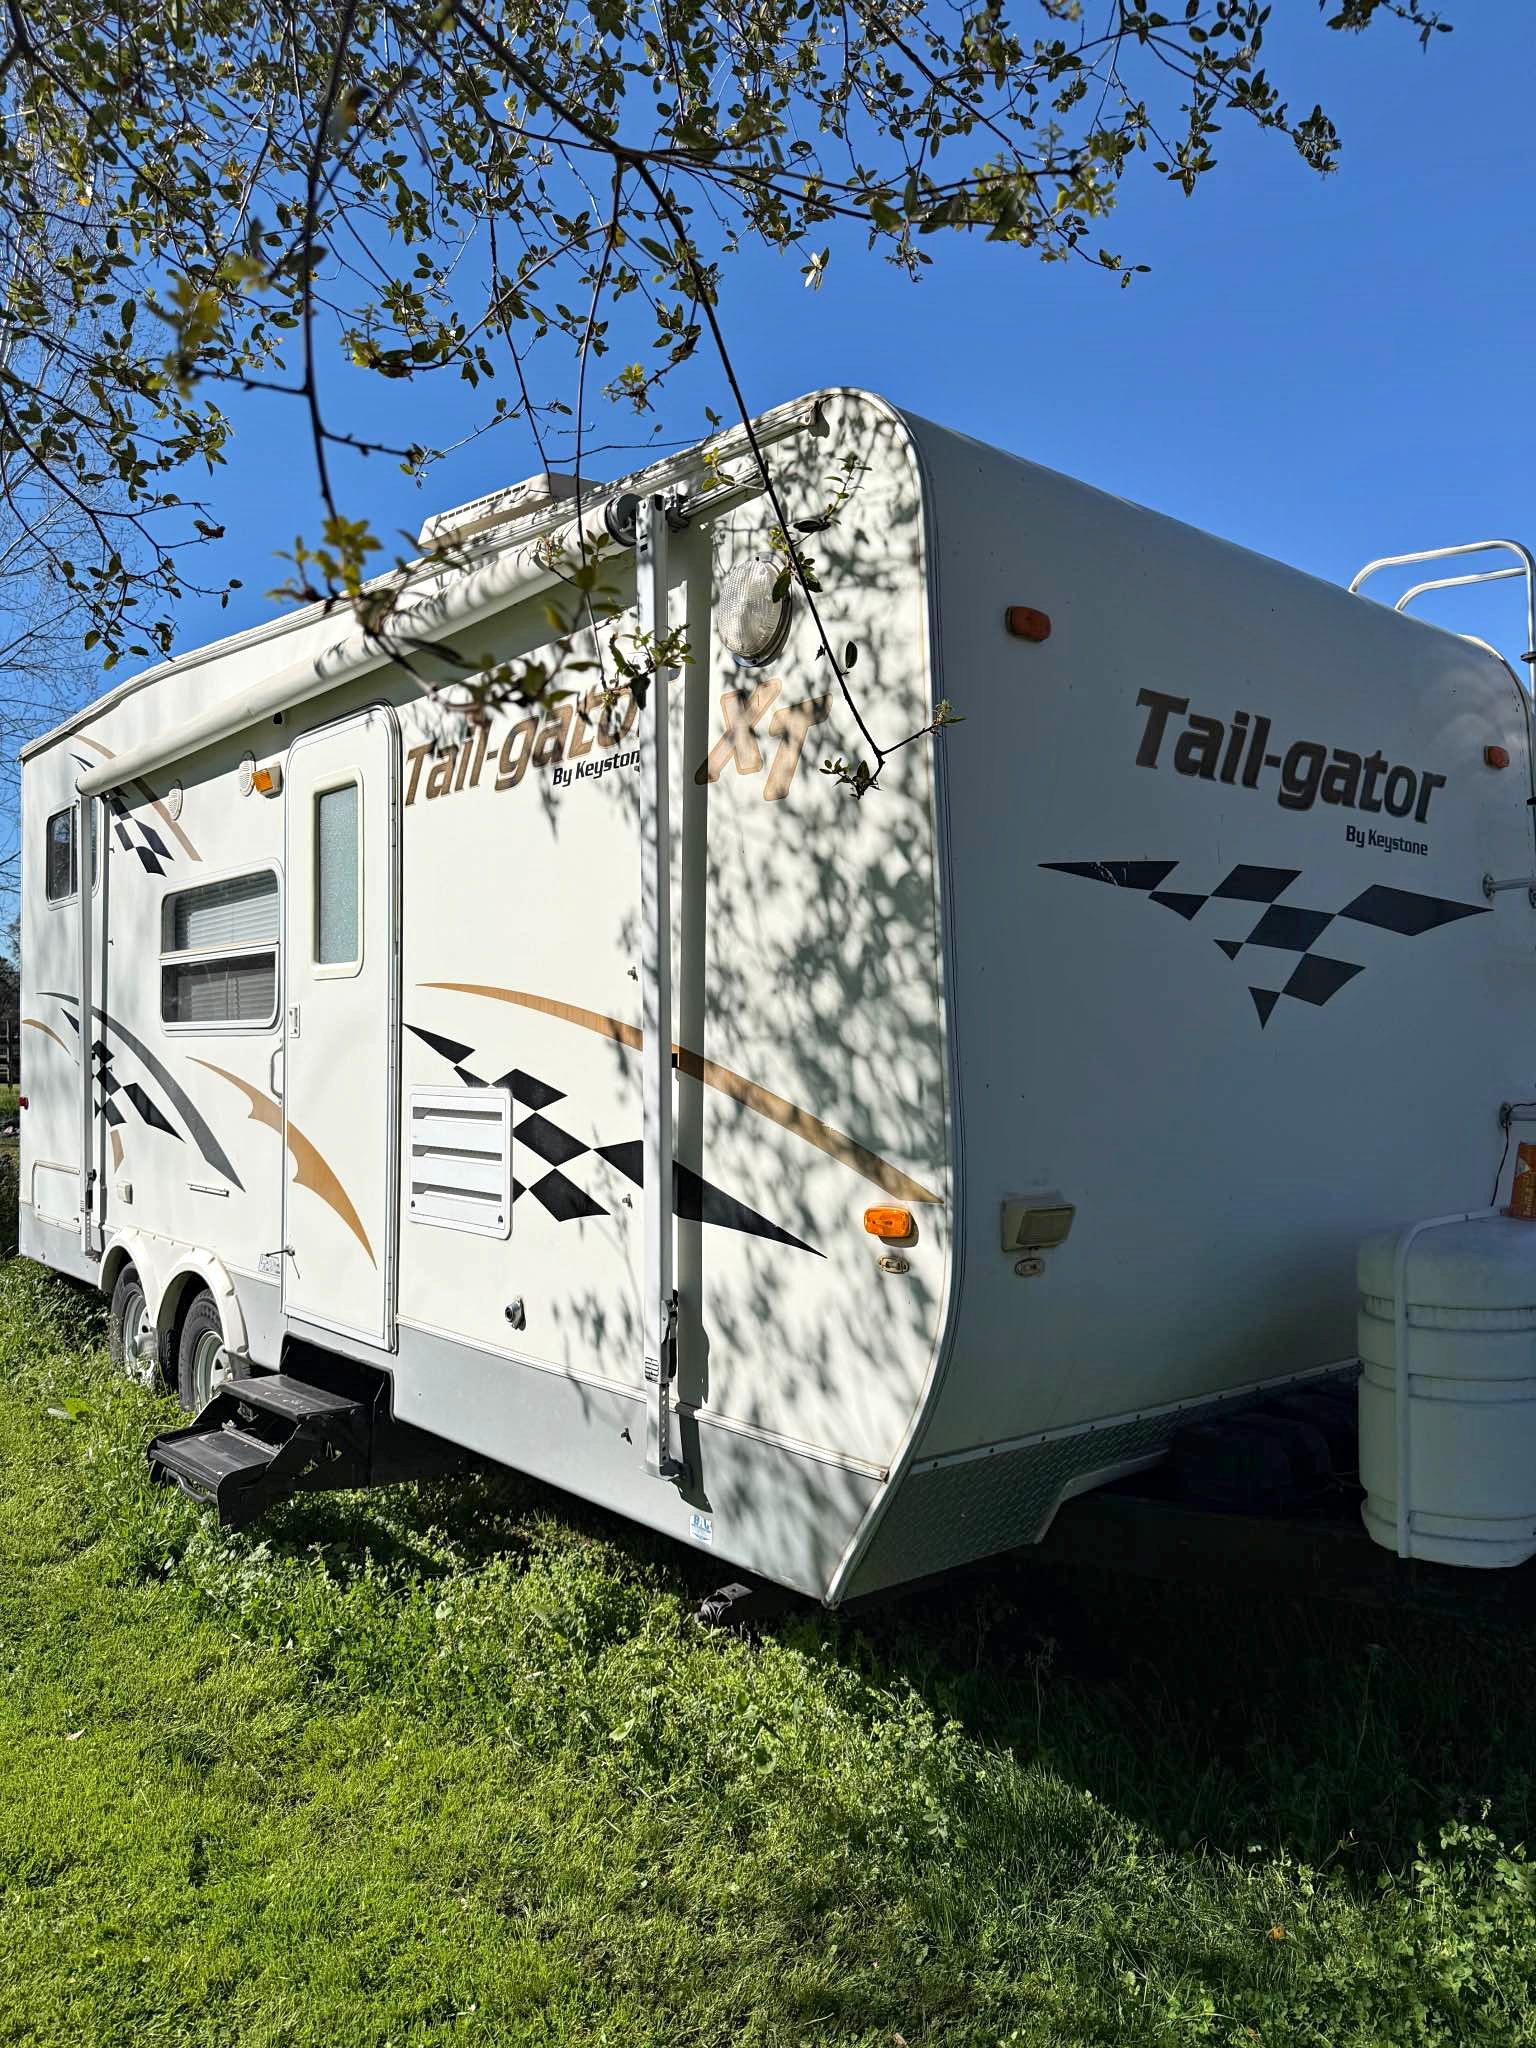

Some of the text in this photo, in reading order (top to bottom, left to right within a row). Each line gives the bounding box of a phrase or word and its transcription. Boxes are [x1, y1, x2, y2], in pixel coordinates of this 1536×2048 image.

[404, 684, 640, 807] Tail-gato
[552, 749, 641, 787] By Keyston
[695, 679, 833, 801] XT
[1135, 688, 1447, 824] Tail-gator
[1345, 824, 1428, 856] By Keystone
